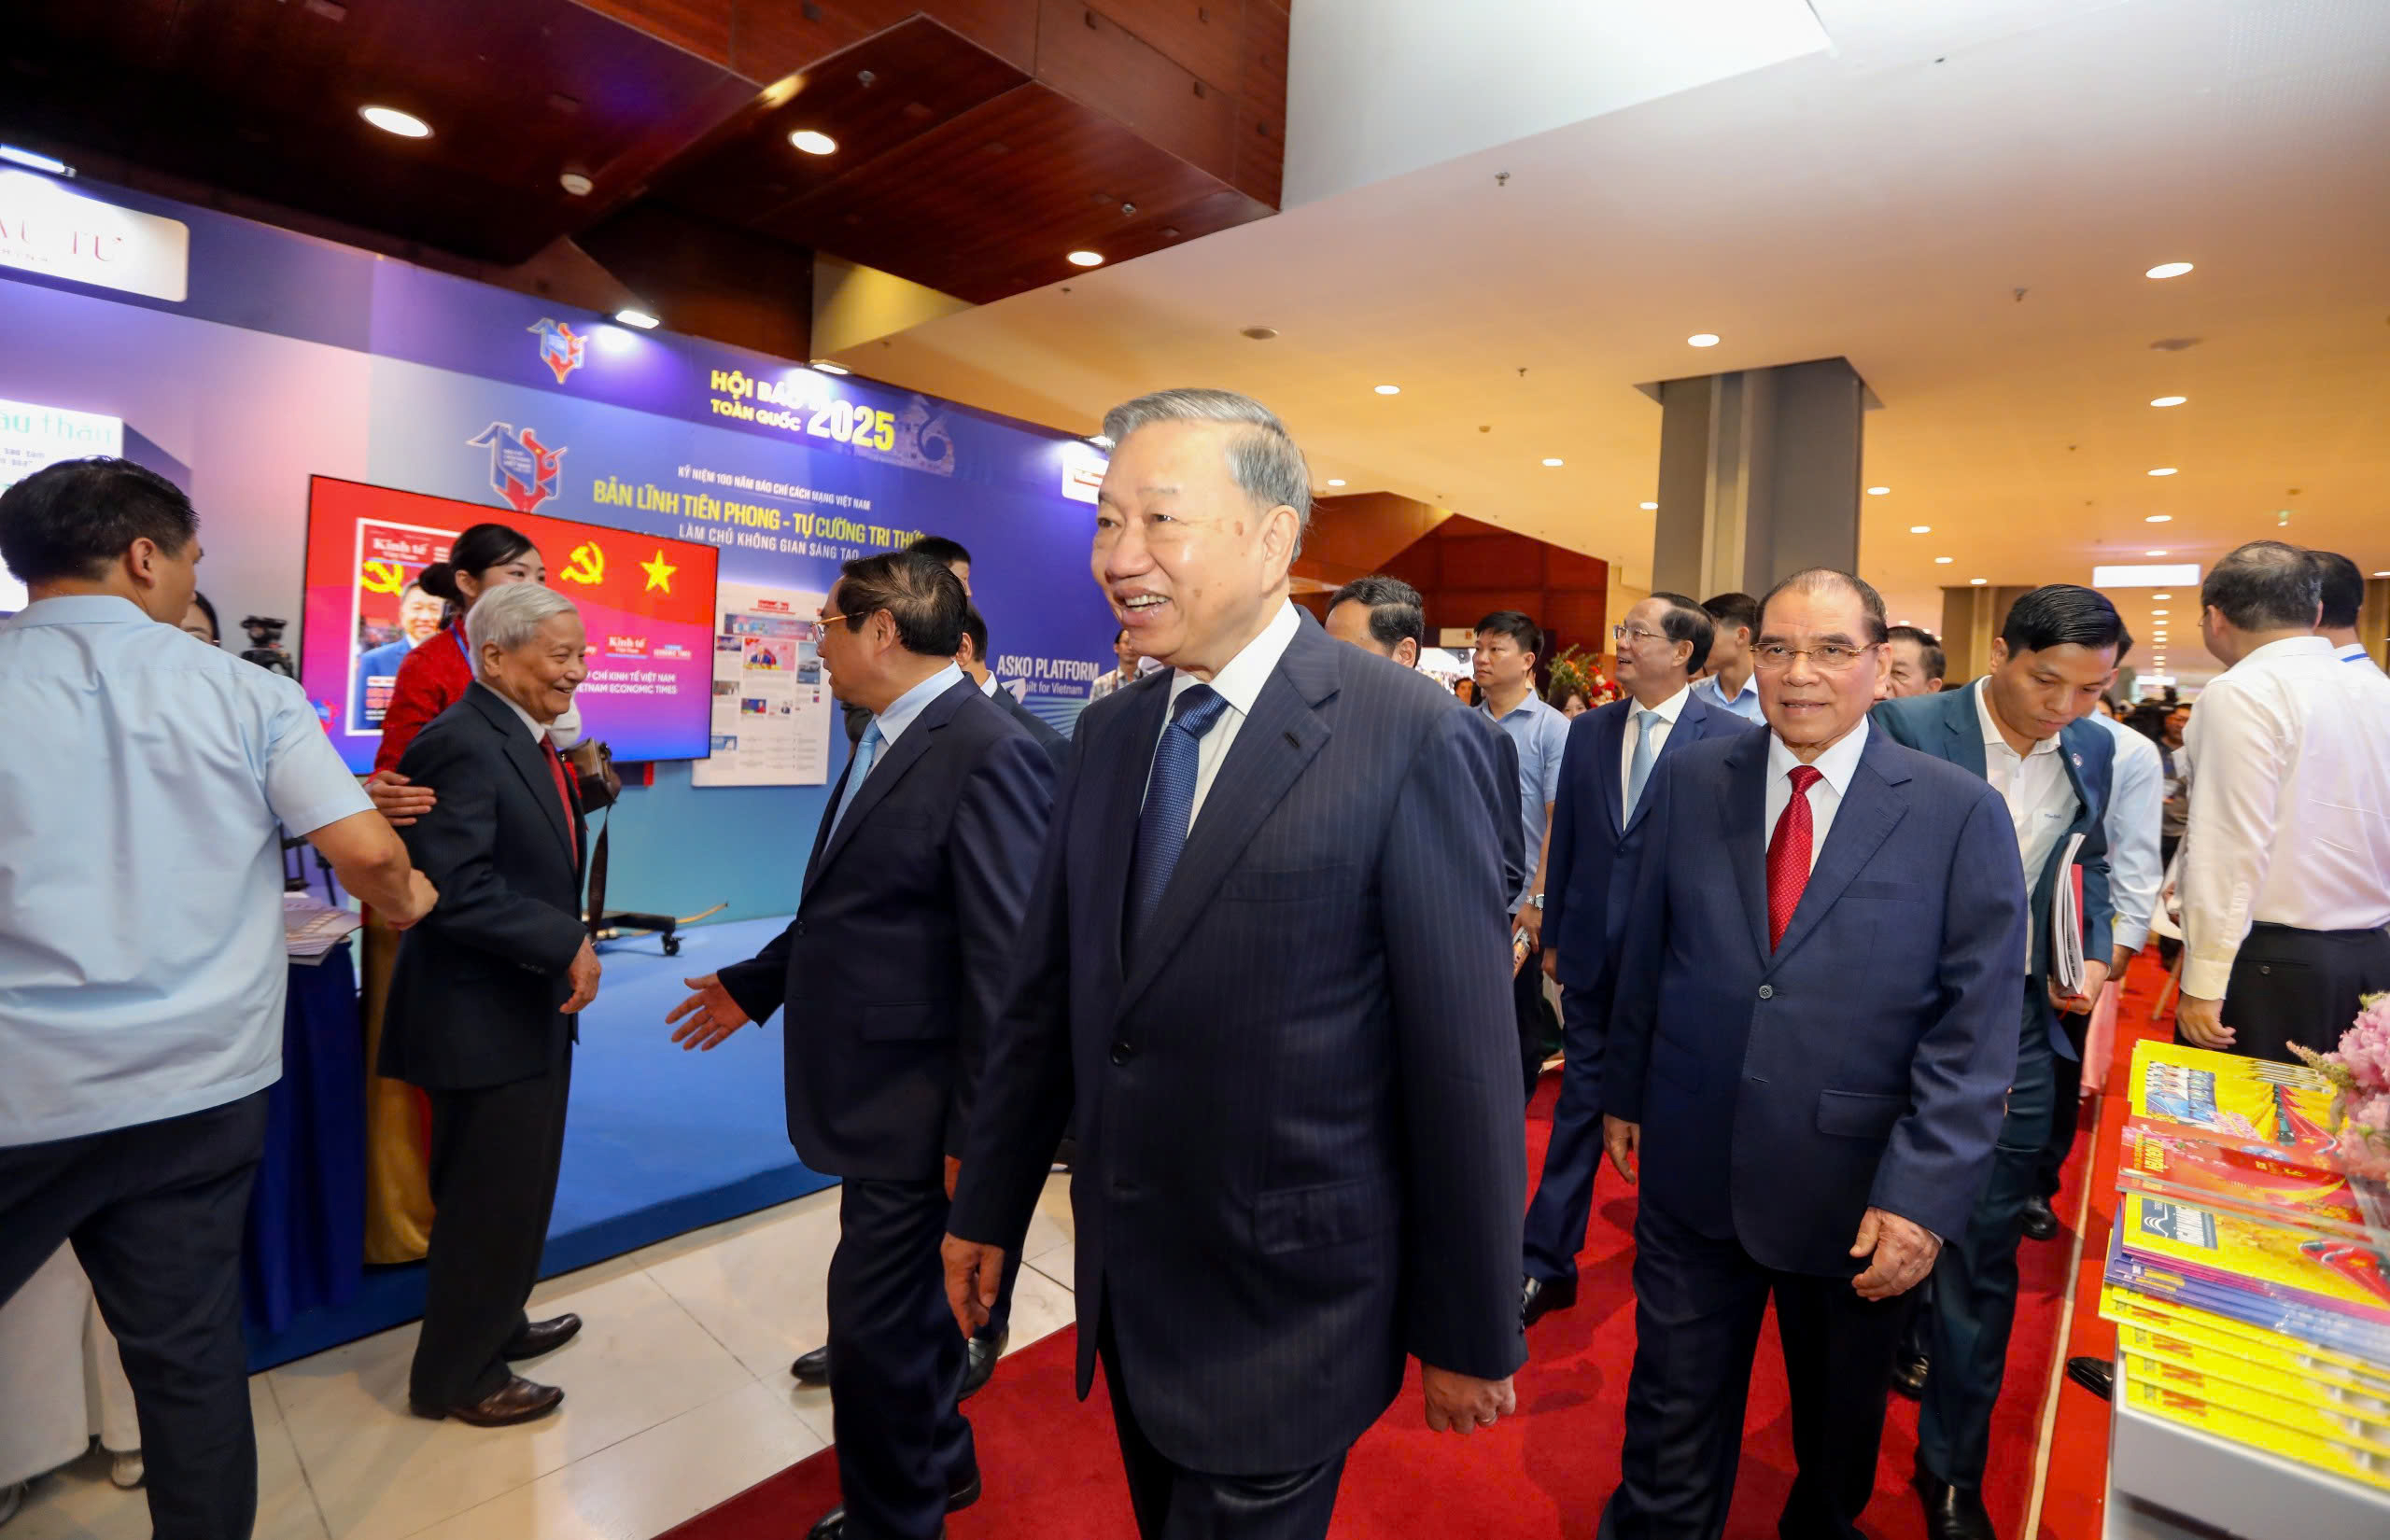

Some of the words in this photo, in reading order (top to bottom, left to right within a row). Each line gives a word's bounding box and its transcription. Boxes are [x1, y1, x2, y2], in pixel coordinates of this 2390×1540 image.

[710, 370, 753, 400] HỘI
[710, 398, 755, 422] TOÀN
[755, 407, 801, 432] QUỐC
[807, 397, 895, 452] 2025
[692, 469, 716, 483] NIỆM
[717, 472, 733, 486] 100
[754, 479, 773, 494] BÁO
[773, 482, 789, 497] CHÍ
[789, 484, 811, 499] CÁCH
[811, 490, 835, 504] MẠNG
[836, 495, 852, 508] VIỆT
[853, 498, 871, 511] NAM
[594, 475, 632, 508] BẢN
[637, 483, 679, 515] LĨNH
[682, 493, 721, 522] TIÊN
[724, 501, 780, 530] PHONG
[793, 512, 815, 539] TỰ
[868, 525, 891, 548] TRI
[893, 529, 926, 549] THỨ
[679, 523, 705, 540] LÀM
[709, 525, 734, 545] CHỦ
[737, 531, 778, 553] KHÔNG
[780, 539, 807, 555] GIAN
[808, 542, 836, 559] SÁNG
[609, 637, 634, 647] Kinh
[610, 670, 627, 682] KINH
[658, 672, 676, 682] NAM
[996, 655, 1033, 678] ASKO
[1034, 657, 1100, 681] PLATFORM
[576, 682, 608, 693] IETNAM
[610, 683, 654, 694] ECONOMIC
[654, 684, 678, 694] TIMES
[1025, 681, 1036, 693] ilt
[1038, 681, 1049, 693] for
[1051, 682, 1083, 695] Vietnam
